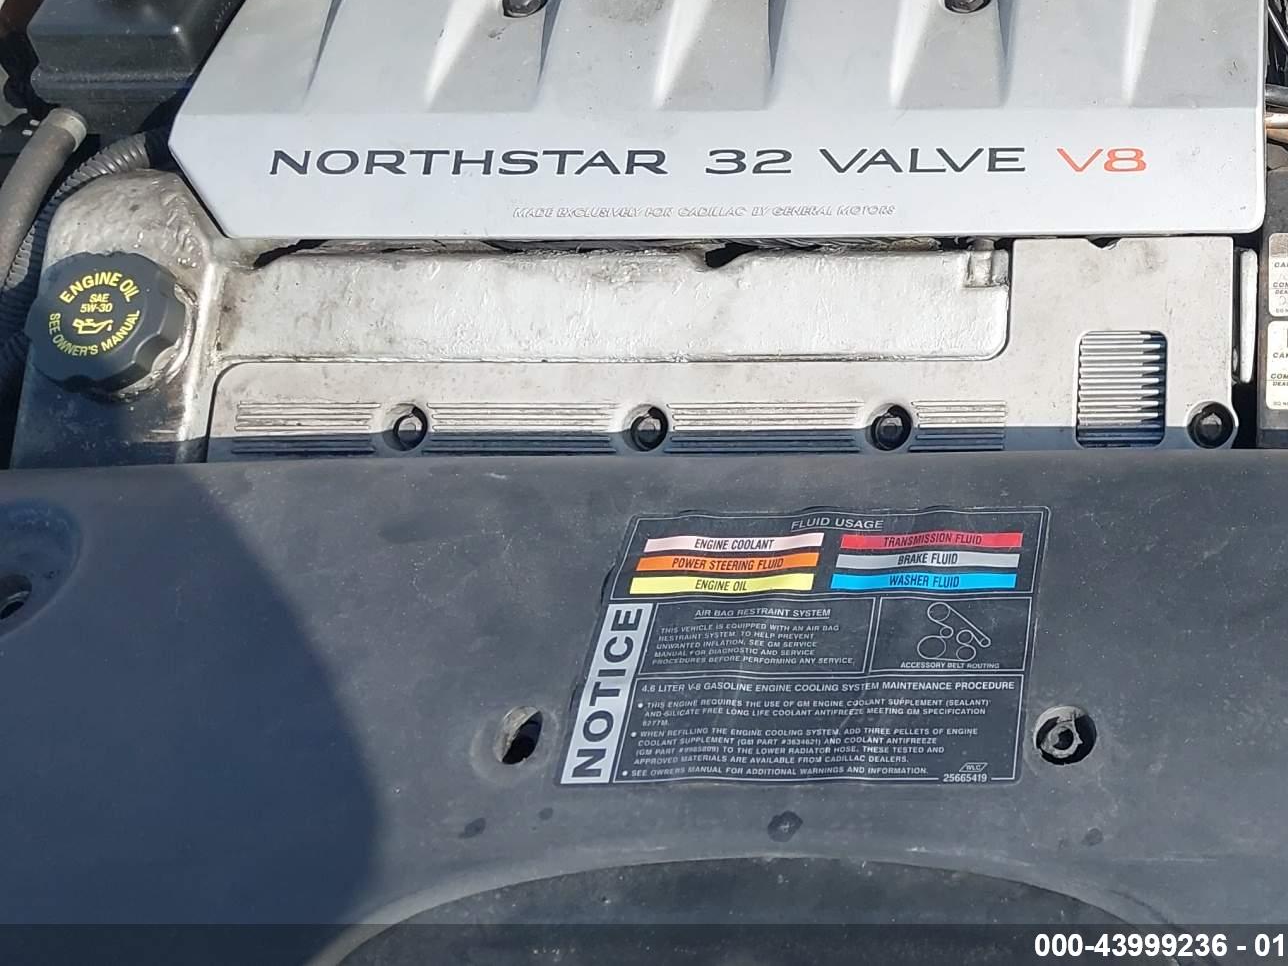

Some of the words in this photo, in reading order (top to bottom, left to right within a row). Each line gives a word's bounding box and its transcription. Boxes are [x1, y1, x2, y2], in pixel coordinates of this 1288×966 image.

[270, 150, 668, 175] NORTHSTAR
[704, 148, 792, 174] 32
[819, 147, 1026, 173] VALVE
[1056, 147, 1148, 172] V8
[512, 206, 553, 218] MADE
[556, 206, 641, 218] EXCLUSIVELY
[645, 207, 674, 218] FOR
[678, 206, 747, 217] CADILLAC
[751, 206, 770, 216] BY
[772, 205, 832, 216] GENERAL
[837, 204, 896, 216] MOTORS
[59, 272, 122, 303] ENGINE
[119, 278, 140, 302] OIL
[90, 293, 110, 303] SAE
[80, 303, 113, 313] 5W-30
[49, 312, 61, 335] SEE
[101, 310, 141, 351] MANUAL
[52, 334, 98, 356] OWNER'S
[791, 517, 830, 530] FLUID
[835, 518, 884, 529] USAGE
[694, 538, 730, 550] ENGINE
[731, 539, 775, 550] COOLANT
[883, 533, 951, 548] TRANSMISSION
[955, 533, 982, 545] FLUID
[672, 558, 706, 570] POWER
[709, 558, 754, 570] STEERING
[757, 558, 784, 569] FLUID
[898, 553, 928, 565] BRAKE
[931, 552, 958, 564] FLUID
[695, 579, 730, 590] ENGINE
[733, 581, 748, 591] OIL
[889, 574, 928, 587] WASHER
[932, 576, 960, 587] FLUID
[737, 608, 791, 616] RESTRAINT
[793, 609, 831, 617] SYSTEM
[681, 624, 713, 632] VEHICLE
[658, 634, 701, 642] RESTRAINT
[742, 656, 797, 664] PERFORMING
[658, 684, 685, 692] LITER
[704, 682, 753, 691] GASOLINE
[842, 682, 879, 692] SYSTEM
[882, 682, 952, 690] MAINTENANCE
[955, 681, 1015, 690] PROCEDURE
[571, 608, 643, 778] NOTICE
[700, 698, 743, 707] REQUIRES
[847, 698, 885, 706] COOLANT
[667, 728, 708, 736] REFILLING
[680, 737, 735, 745] SUPPLEMENT
[634, 756, 678, 765] APPROVED
[943, 773, 987, 782] 25665419
